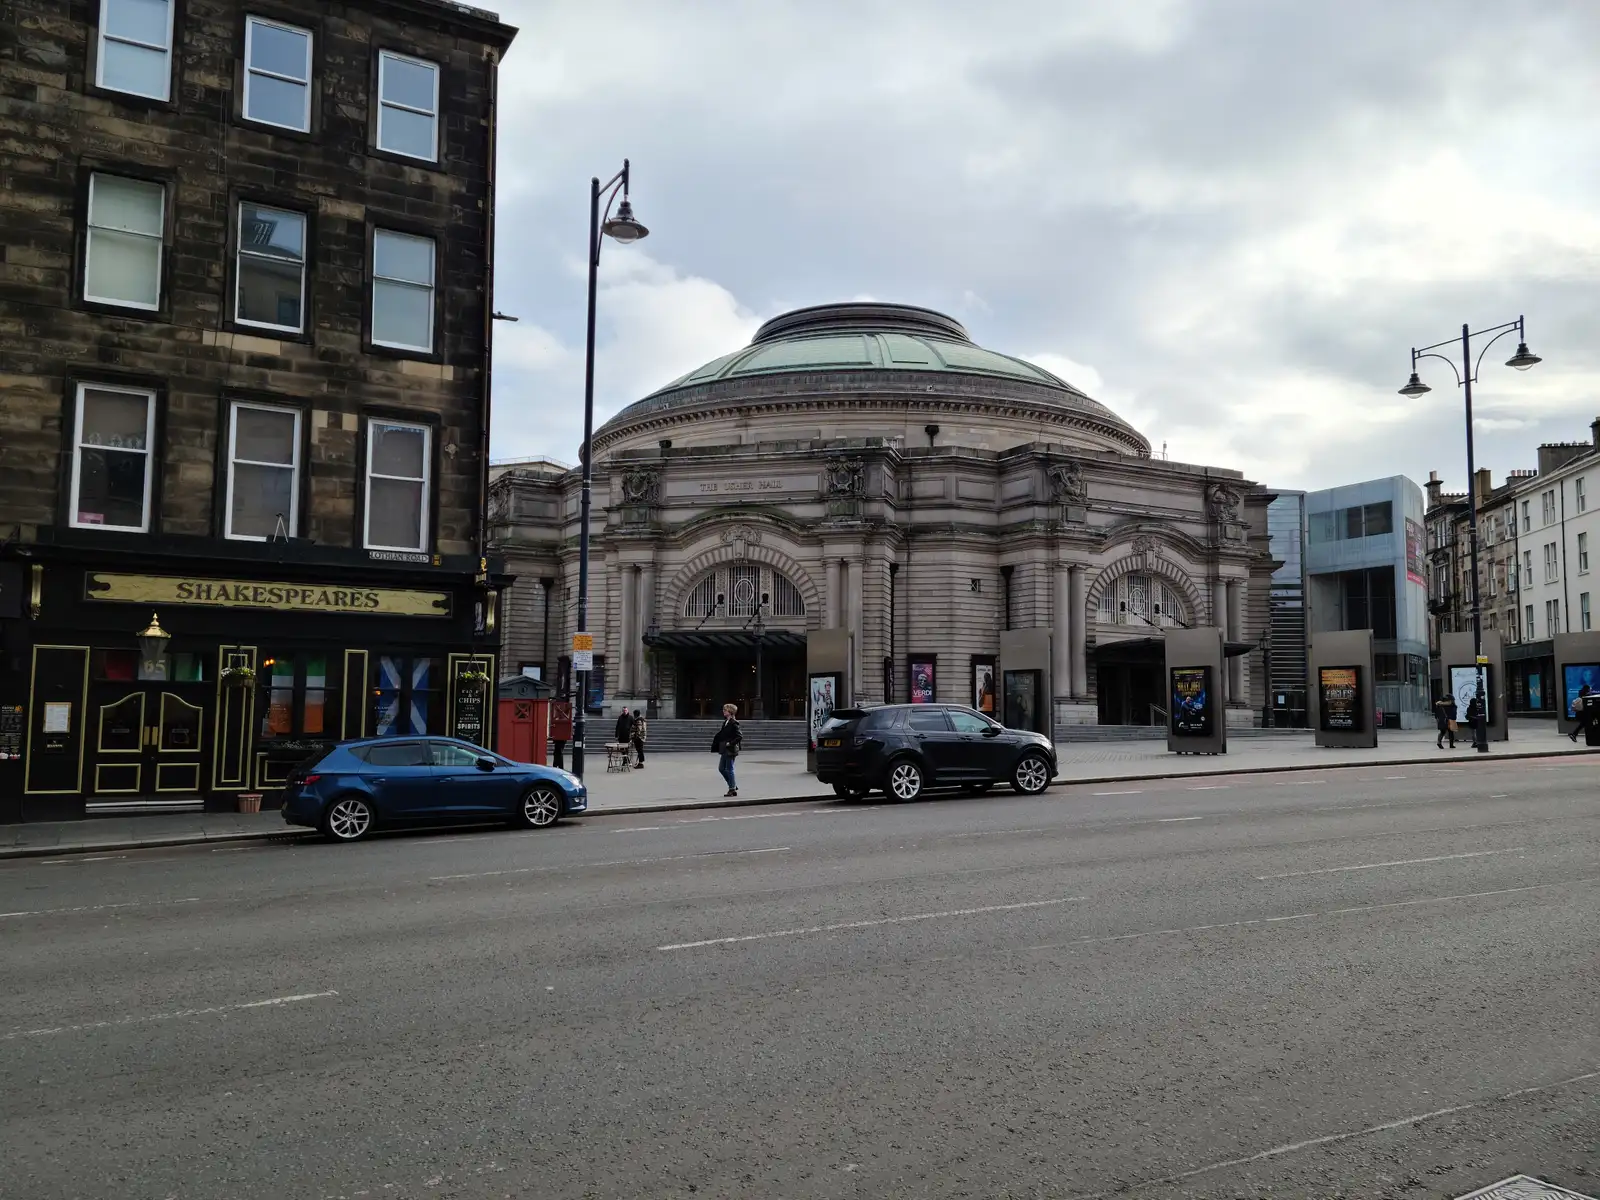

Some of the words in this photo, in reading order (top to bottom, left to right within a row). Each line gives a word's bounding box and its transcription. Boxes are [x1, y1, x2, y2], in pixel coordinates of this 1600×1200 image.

[700, 483, 718, 492] THE
[724, 481, 754, 491] USHER
[758, 480, 784, 490] HALL
[370, 551, 403, 560] LOTHIAN
[405, 554, 429, 562] ROAD
[175, 582, 380, 608] SHAKESPEARES
[144, 659, 166, 674] 65
